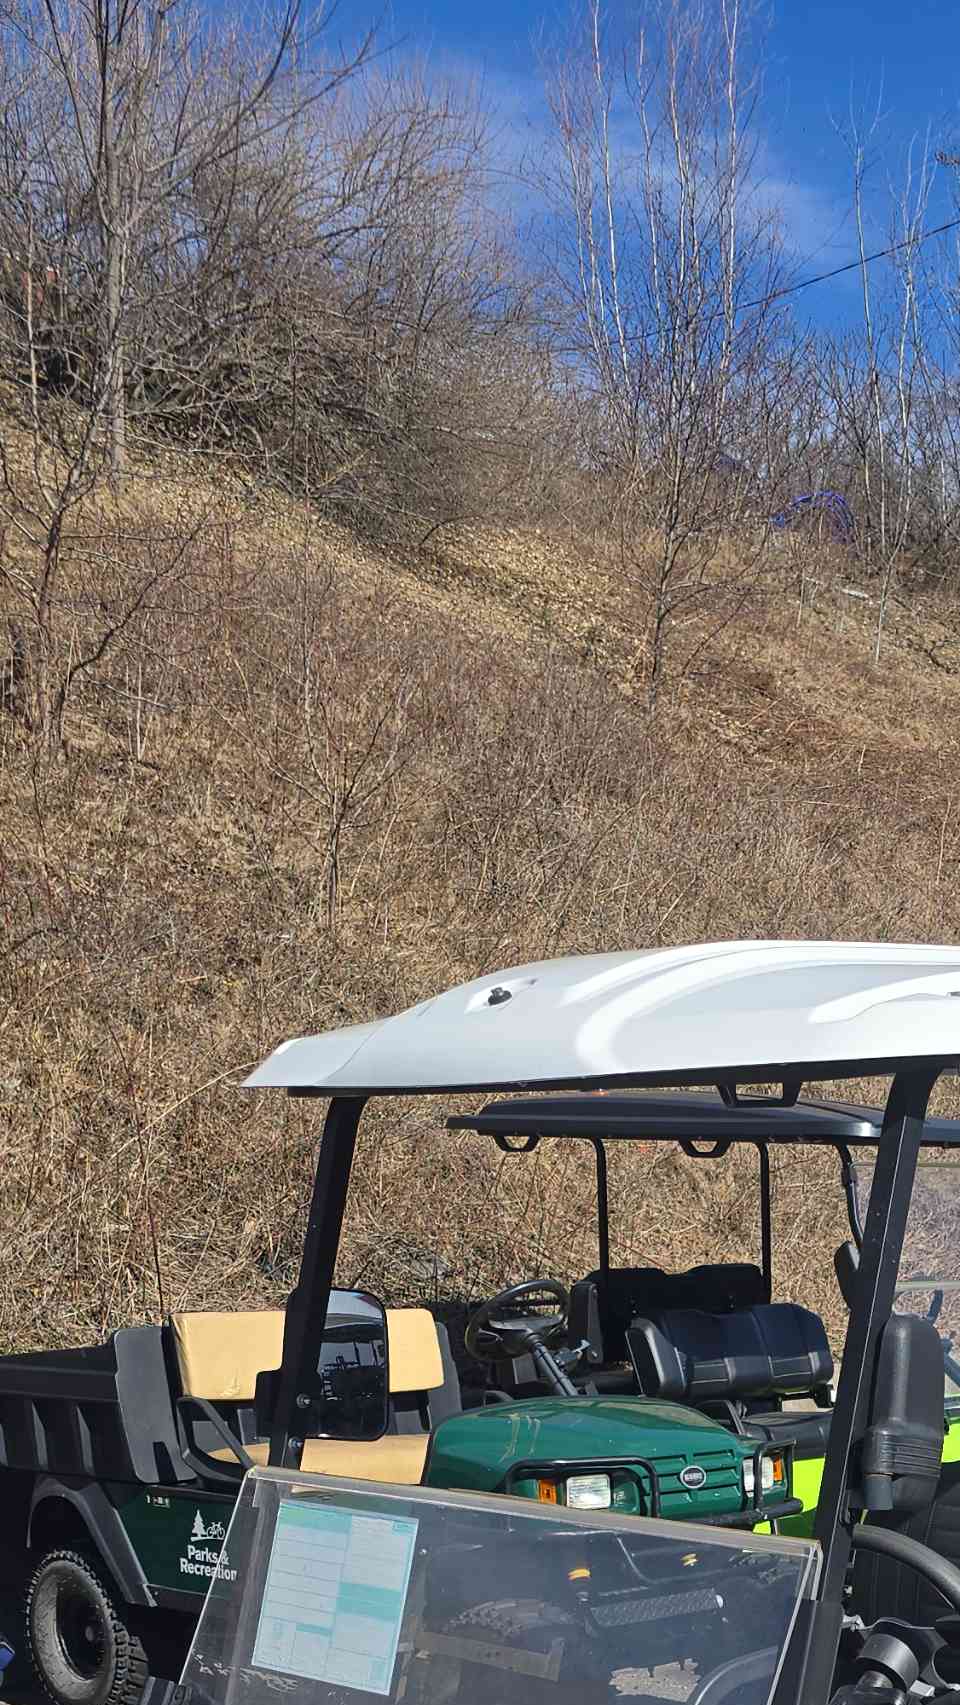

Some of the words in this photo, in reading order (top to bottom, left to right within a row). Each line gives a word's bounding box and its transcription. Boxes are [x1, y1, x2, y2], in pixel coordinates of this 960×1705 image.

[187, 1545, 219, 1564] Parks
[219, 1550, 230, 1565] &
[179, 1558, 238, 1580] Recreation
